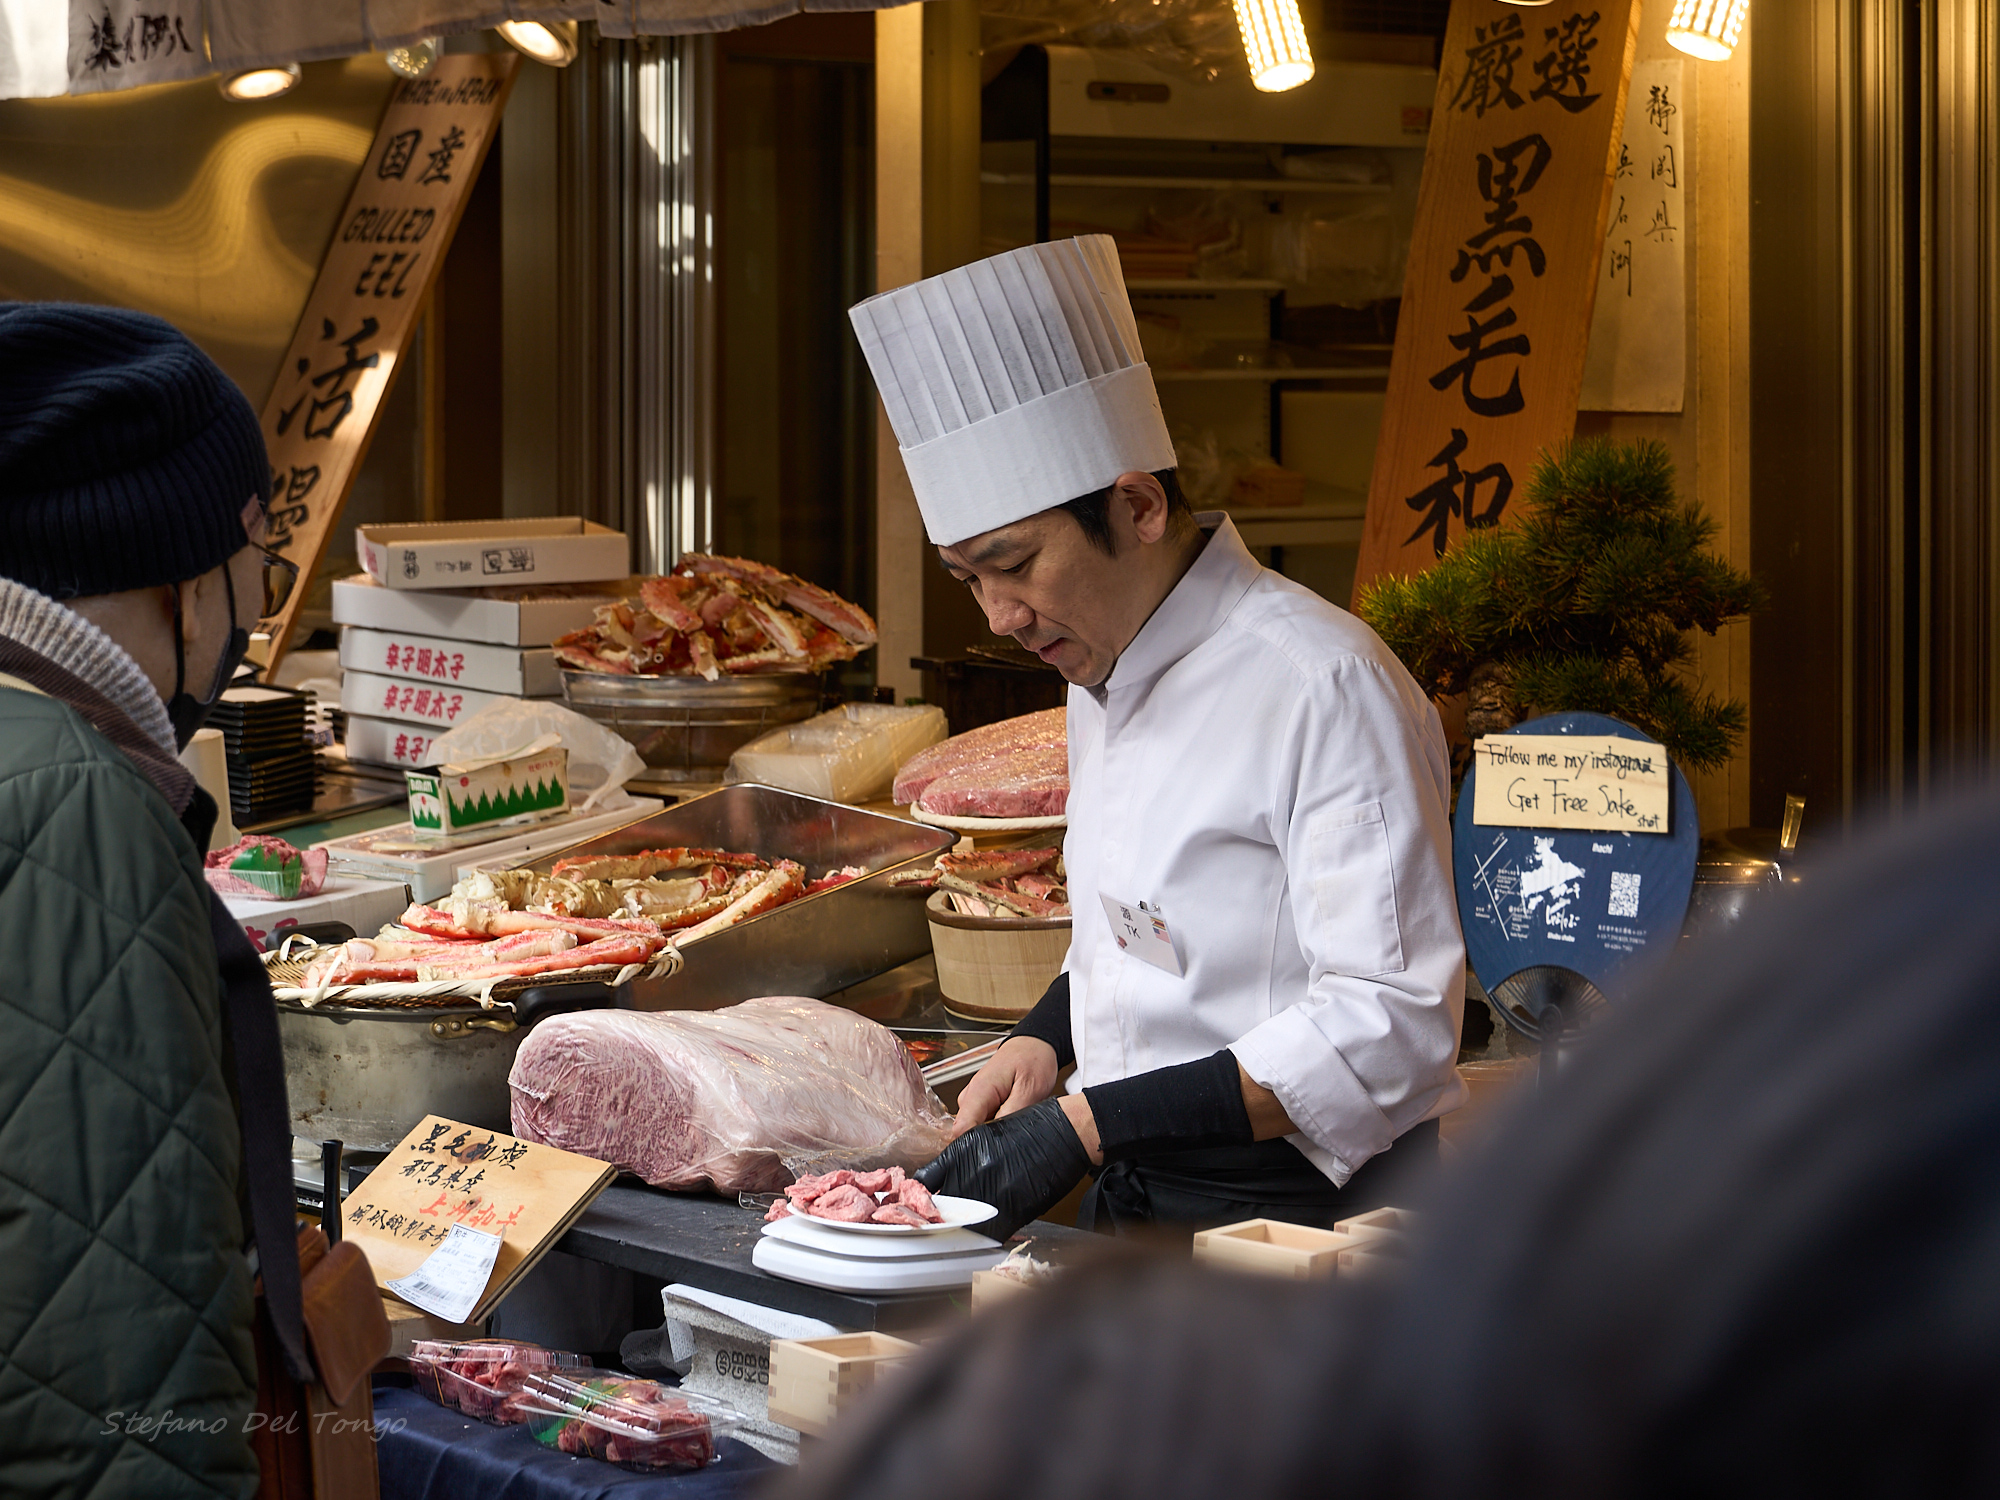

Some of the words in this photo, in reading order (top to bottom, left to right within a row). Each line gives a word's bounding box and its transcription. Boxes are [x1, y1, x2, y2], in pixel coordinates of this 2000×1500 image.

[1447, 11, 1603, 118] 厳選
[447, 76, 504, 105] JAPAN
[378, 125, 466, 186] 国産
[1643, 85, 1678, 243] 静岡県
[342, 207, 436, 243] GRILLED
[355, 252, 421, 298] EEL
[1401, 133, 1552, 560] 黒毛和
[385, 642, 466, 681] 辛子明太子
[383, 684, 464, 721] 辛子明太子
[393, 733, 432, 763] 辛子
[1484, 743, 1530, 766] Follow
[1537, 753, 1558, 766] me
[1564, 754, 1588, 779] my
[1507, 777, 1540, 812] Get
[1543, 777, 1588, 815] Free
[1597, 785, 1638, 819] Sake
[1124, 923, 1141, 939] TK
[731, 1351, 744, 1380] GB
[744, 1353, 757, 1383] KB
